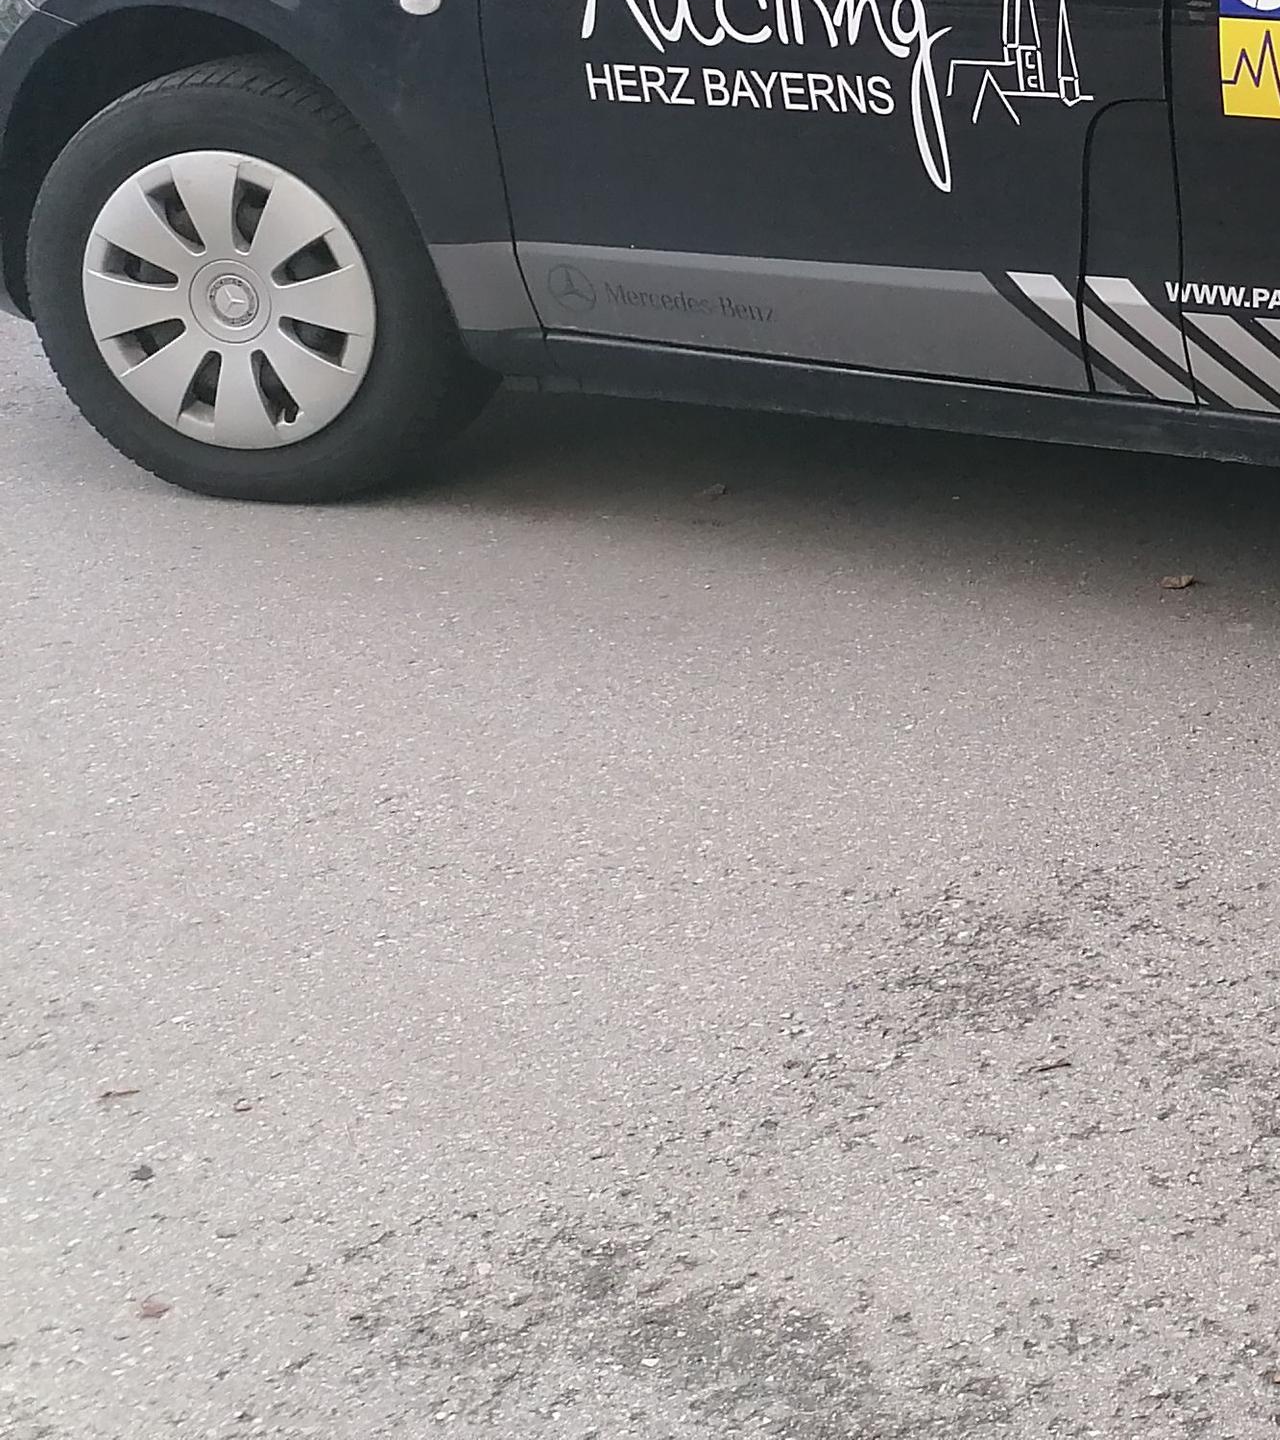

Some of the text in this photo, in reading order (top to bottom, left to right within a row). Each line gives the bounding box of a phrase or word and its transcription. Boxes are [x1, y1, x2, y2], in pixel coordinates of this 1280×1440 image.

[585, 63, 895, 115] HERZ BAYERNS
[604, 281, 776, 322] Mercedes-Benz
